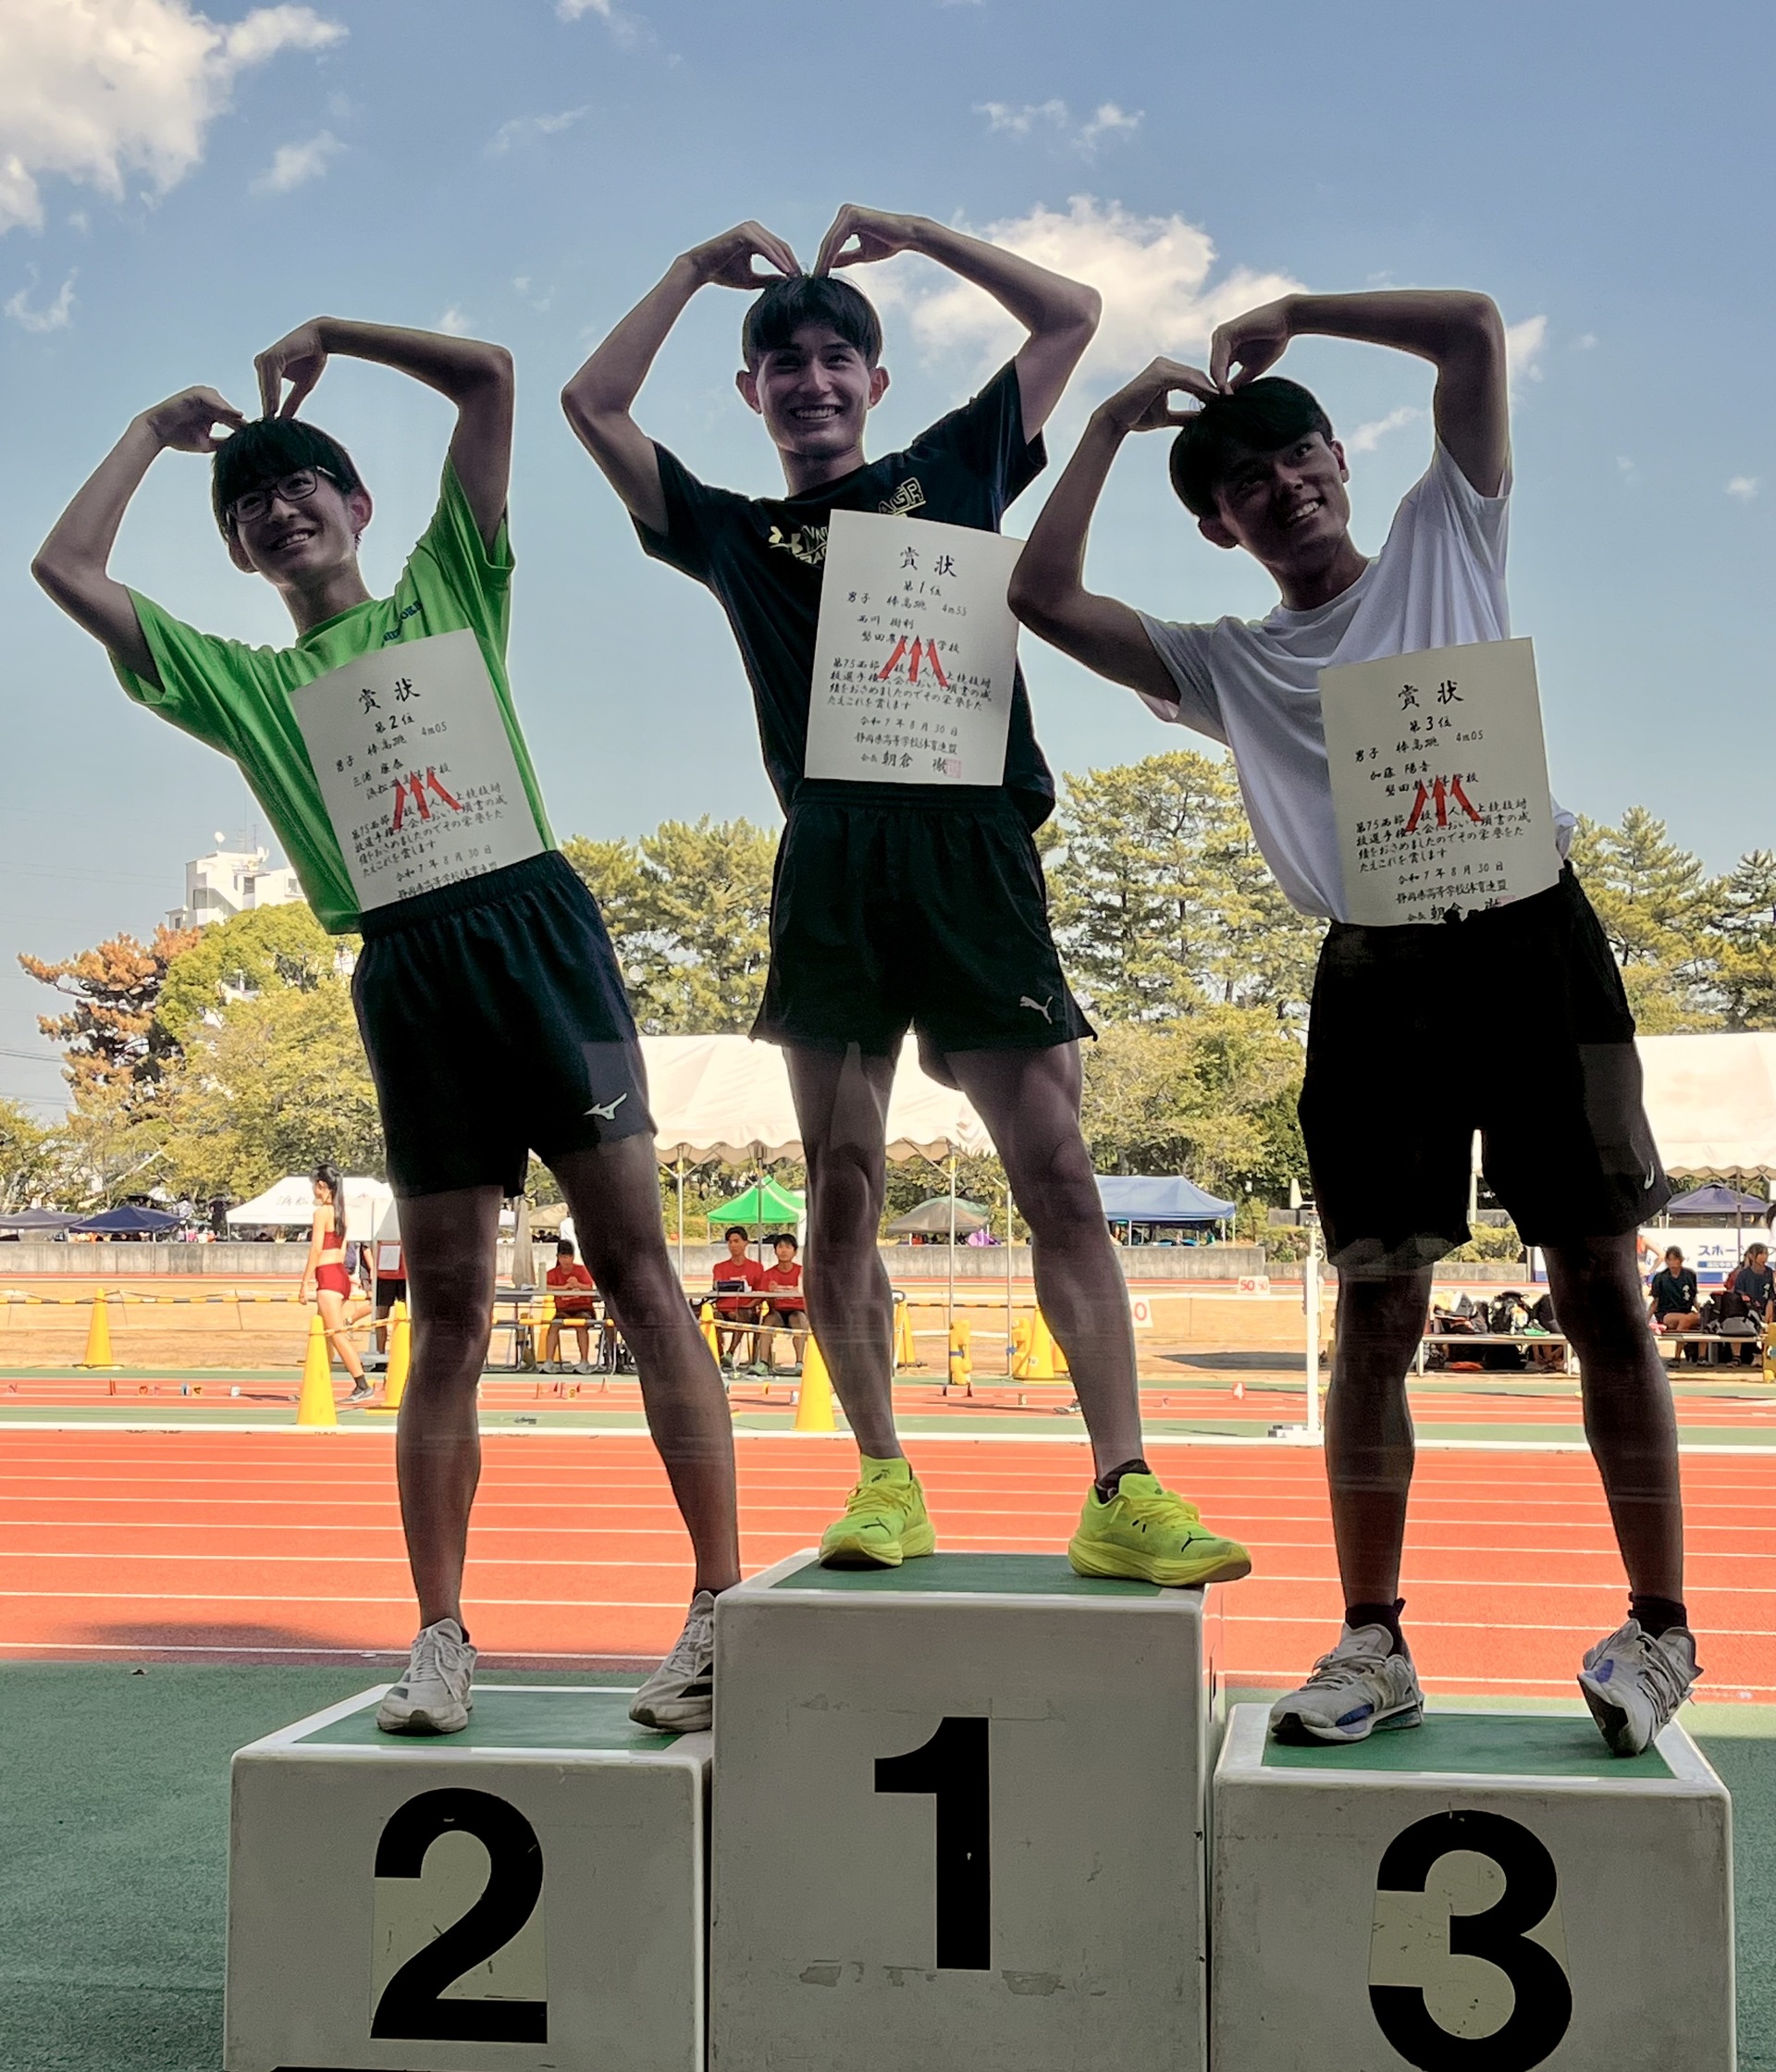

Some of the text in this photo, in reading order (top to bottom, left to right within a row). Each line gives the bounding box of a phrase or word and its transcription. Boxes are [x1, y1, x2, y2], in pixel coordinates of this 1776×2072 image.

[900, 547, 957, 577] 賞状
[847, 591, 870, 604] 男子
[904, 580, 942, 596] 第1位
[358, 678, 421, 714] 賞状
[1398, 680, 1464, 710] 賞状
[375, 712, 415, 734] 第2位
[1410, 716, 1452, 734] 第3位
[1355, 747, 1378, 762] 男子
[1240, 1279, 1255, 1291] 50
[875, 1718, 990, 1969] 1
[371, 1788, 547, 2043] 2
[1369, 1810, 1572, 2072] 3
